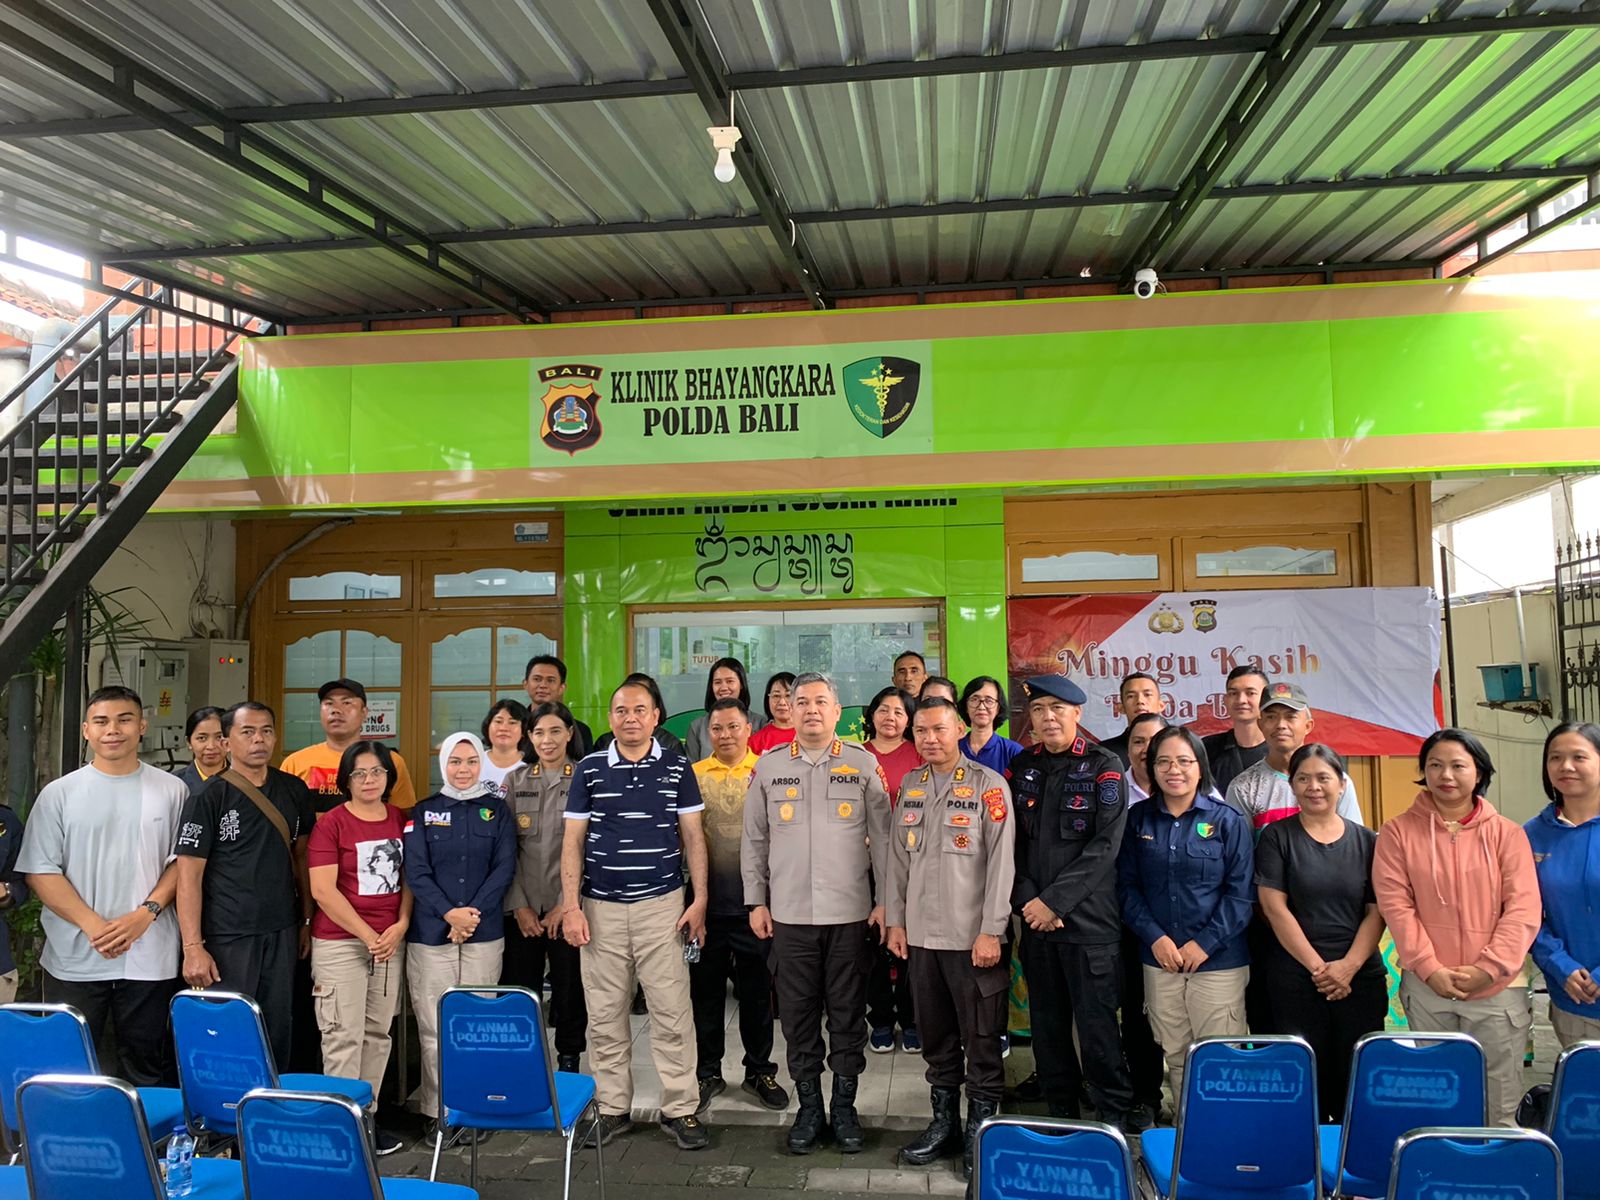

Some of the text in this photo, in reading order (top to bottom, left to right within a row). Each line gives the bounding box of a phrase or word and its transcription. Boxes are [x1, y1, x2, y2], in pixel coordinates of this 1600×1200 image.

[545, 367, 595, 378] BALI
[611, 363, 836, 403] KLINIK BHAYANGKARA
[643, 403, 799, 436] POLDA BALI
[1056, 641, 1320, 684] Minggu Kasih
[366, 724, 390, 732] DRUGS
[771, 777, 800, 785] ARSDO
[830, 775, 859, 784] POLRI
[1064, 782, 1094, 792] POLRI
[947, 800, 978, 810] POLRI
[467, 1022, 518, 1033] YANMA
[457, 1032, 529, 1043] POLDA BALI
[1219, 1067, 1282, 1081] YANMA
[1205, 1080, 1295, 1093] POLDA BALI
[1015, 1161, 1094, 1184] YANMA
[1000, 1174, 1063, 1194] POLDA
